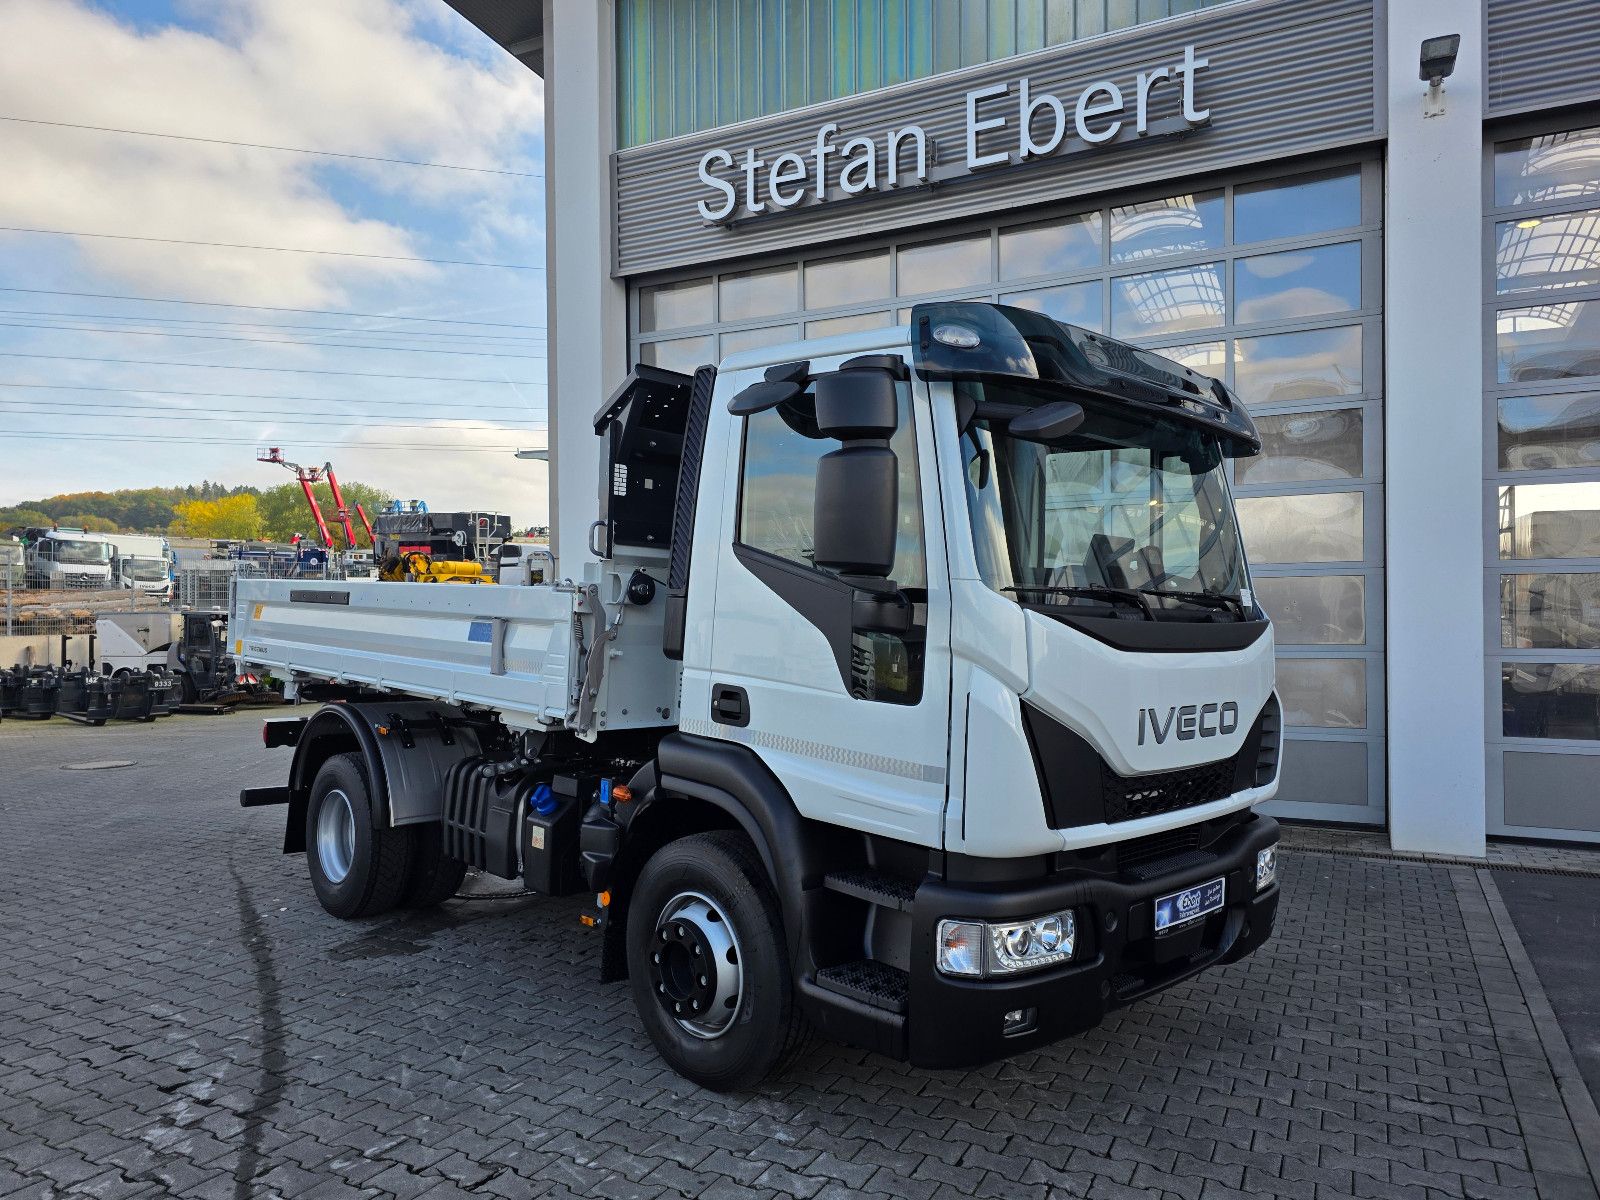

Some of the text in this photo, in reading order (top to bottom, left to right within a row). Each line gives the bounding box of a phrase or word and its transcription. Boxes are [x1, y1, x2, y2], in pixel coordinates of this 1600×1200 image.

[697, 44, 1211, 223] Stefan Ebert
[1137, 701, 1239, 746] IVECO
